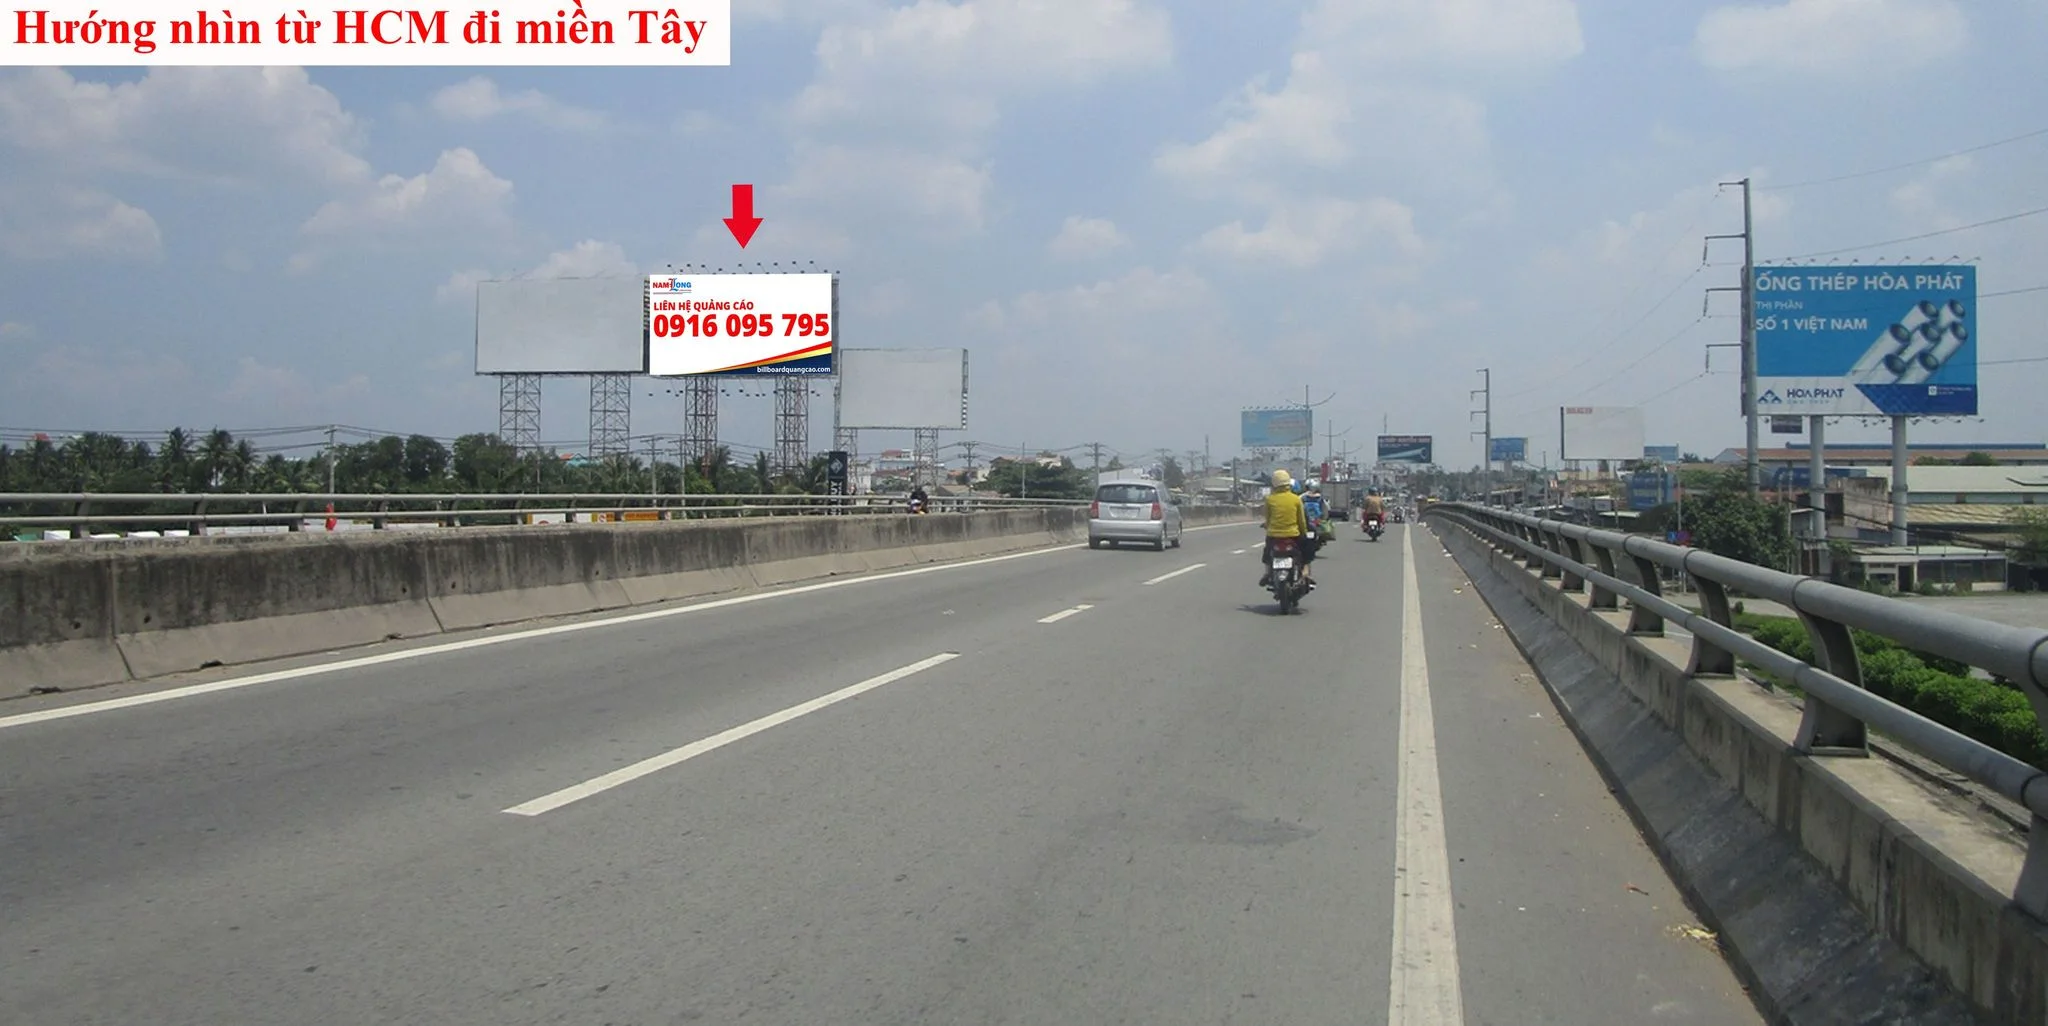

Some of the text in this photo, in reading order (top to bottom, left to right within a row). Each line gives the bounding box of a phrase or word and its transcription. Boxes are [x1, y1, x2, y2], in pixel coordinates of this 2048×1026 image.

[1756, 270, 1964, 291] ỐNG THÉP HÒA PHÁT
[653, 299, 754, 313] LIÊN HỆ QUẢNG CÁO
[653, 313, 830, 337] 0916 095 795
[1755, 314, 1867, 334] SỐ 1 VIỆT NAM
[757, 366, 831, 374] billboardquangcao.com
